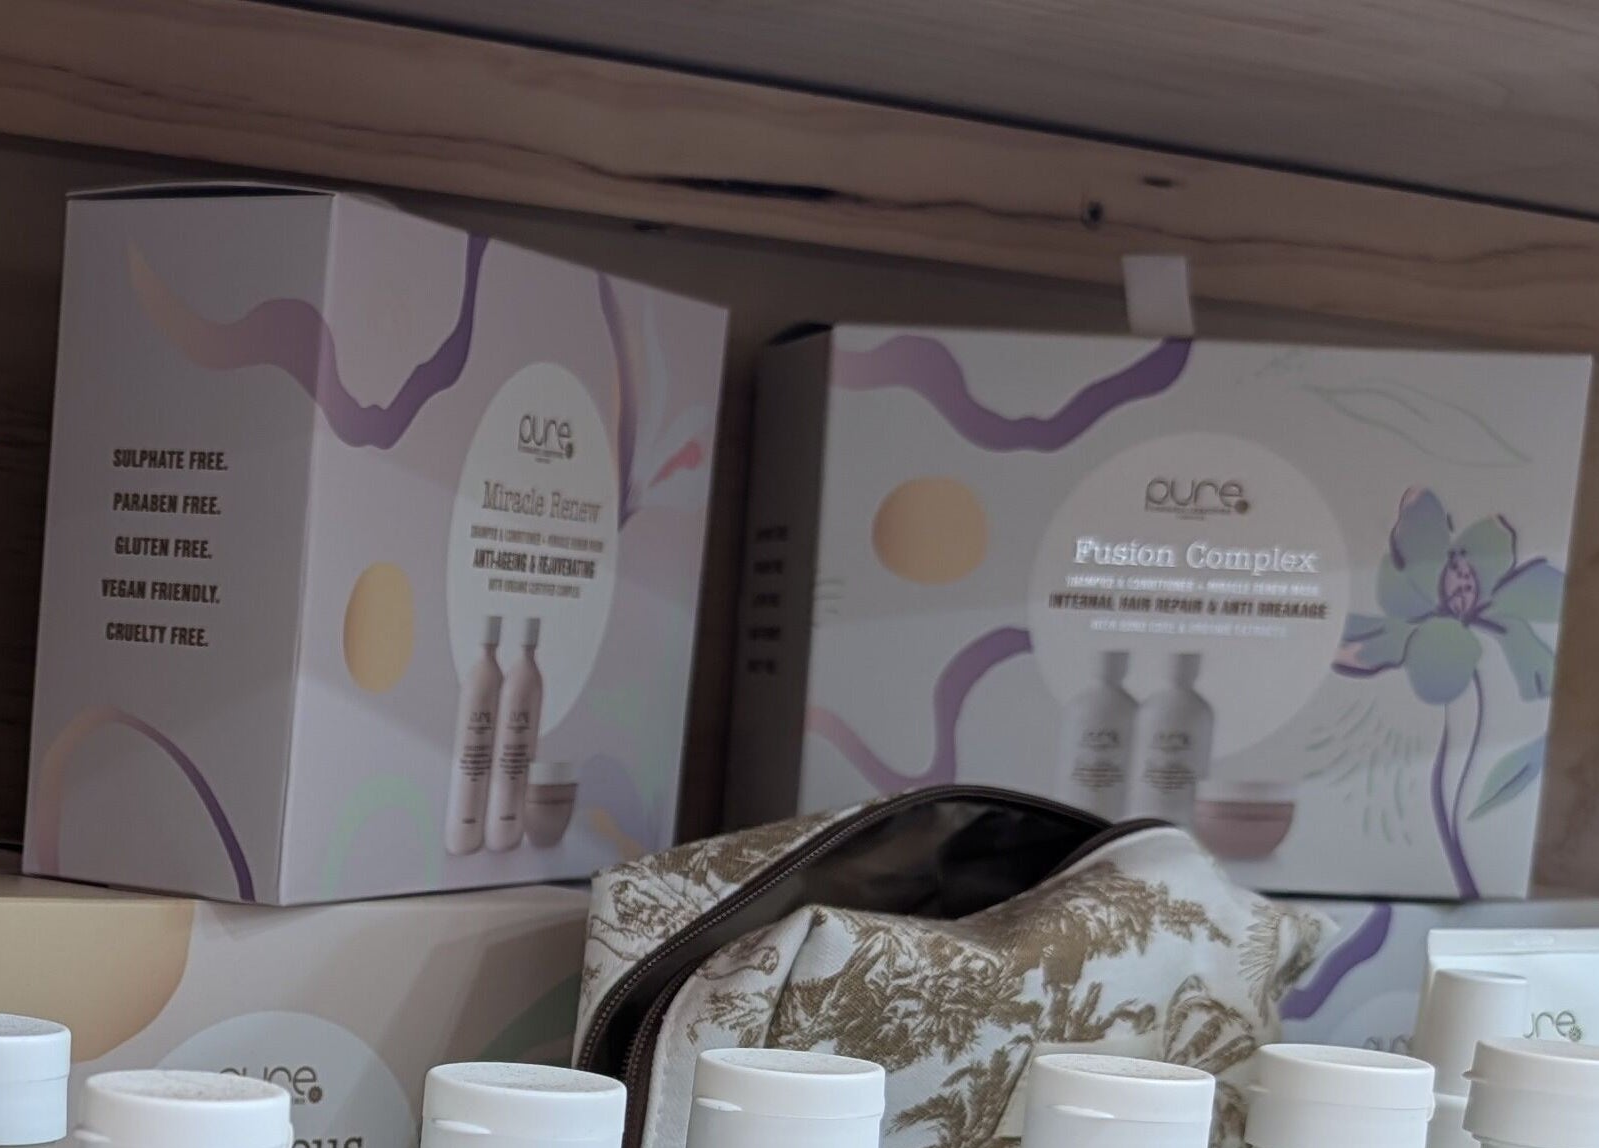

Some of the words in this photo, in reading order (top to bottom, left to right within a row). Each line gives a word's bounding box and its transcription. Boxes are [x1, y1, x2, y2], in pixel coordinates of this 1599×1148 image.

[112, 449, 184, 469] SULPHATE
[189, 452, 228, 470] FREE.
[112, 493, 177, 513] PARABEN
[182, 496, 221, 515] FREE.
[1145, 477, 1244, 512] pure
[115, 536, 169, 556] GLUTEN
[174, 539, 212, 559] FREE.
[1074, 537, 1176, 567] Fusion
[1186, 542, 1319, 576] Complex
[101, 579, 146, 599] VEGAN
[151, 582, 220, 603] FRIENDLY.
[106, 622, 167, 643] CRUELTY
[170, 627, 209, 647] FREE.
